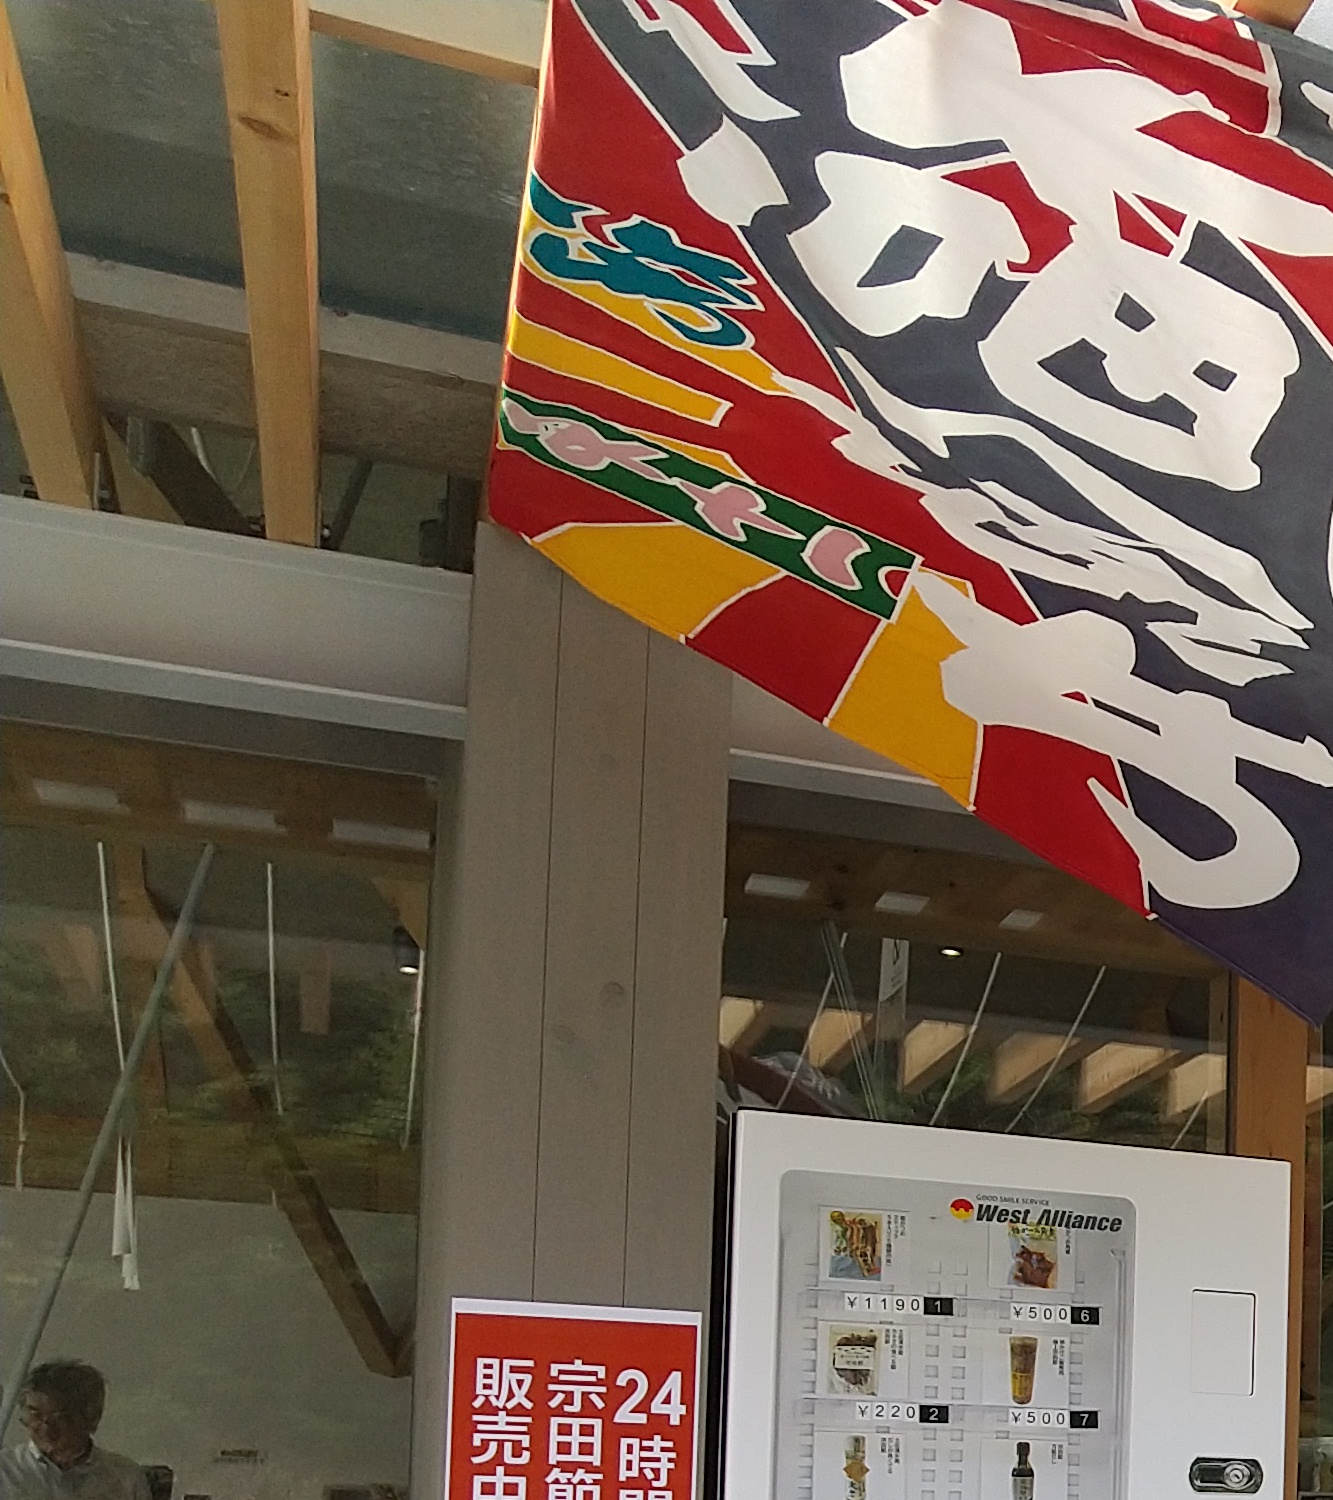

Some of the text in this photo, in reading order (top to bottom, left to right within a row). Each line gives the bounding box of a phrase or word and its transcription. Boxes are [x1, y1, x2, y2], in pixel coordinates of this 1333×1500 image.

[976, 1203, 1123, 1232] West Alliance
[847, 1296, 920, 1311] ¥1190
[1013, 1306, 1090, 1322] ¥500 6
[858, 1405, 939, 1420] ¥220 2
[1011, 1411, 1089, 1426] ¥500 7
